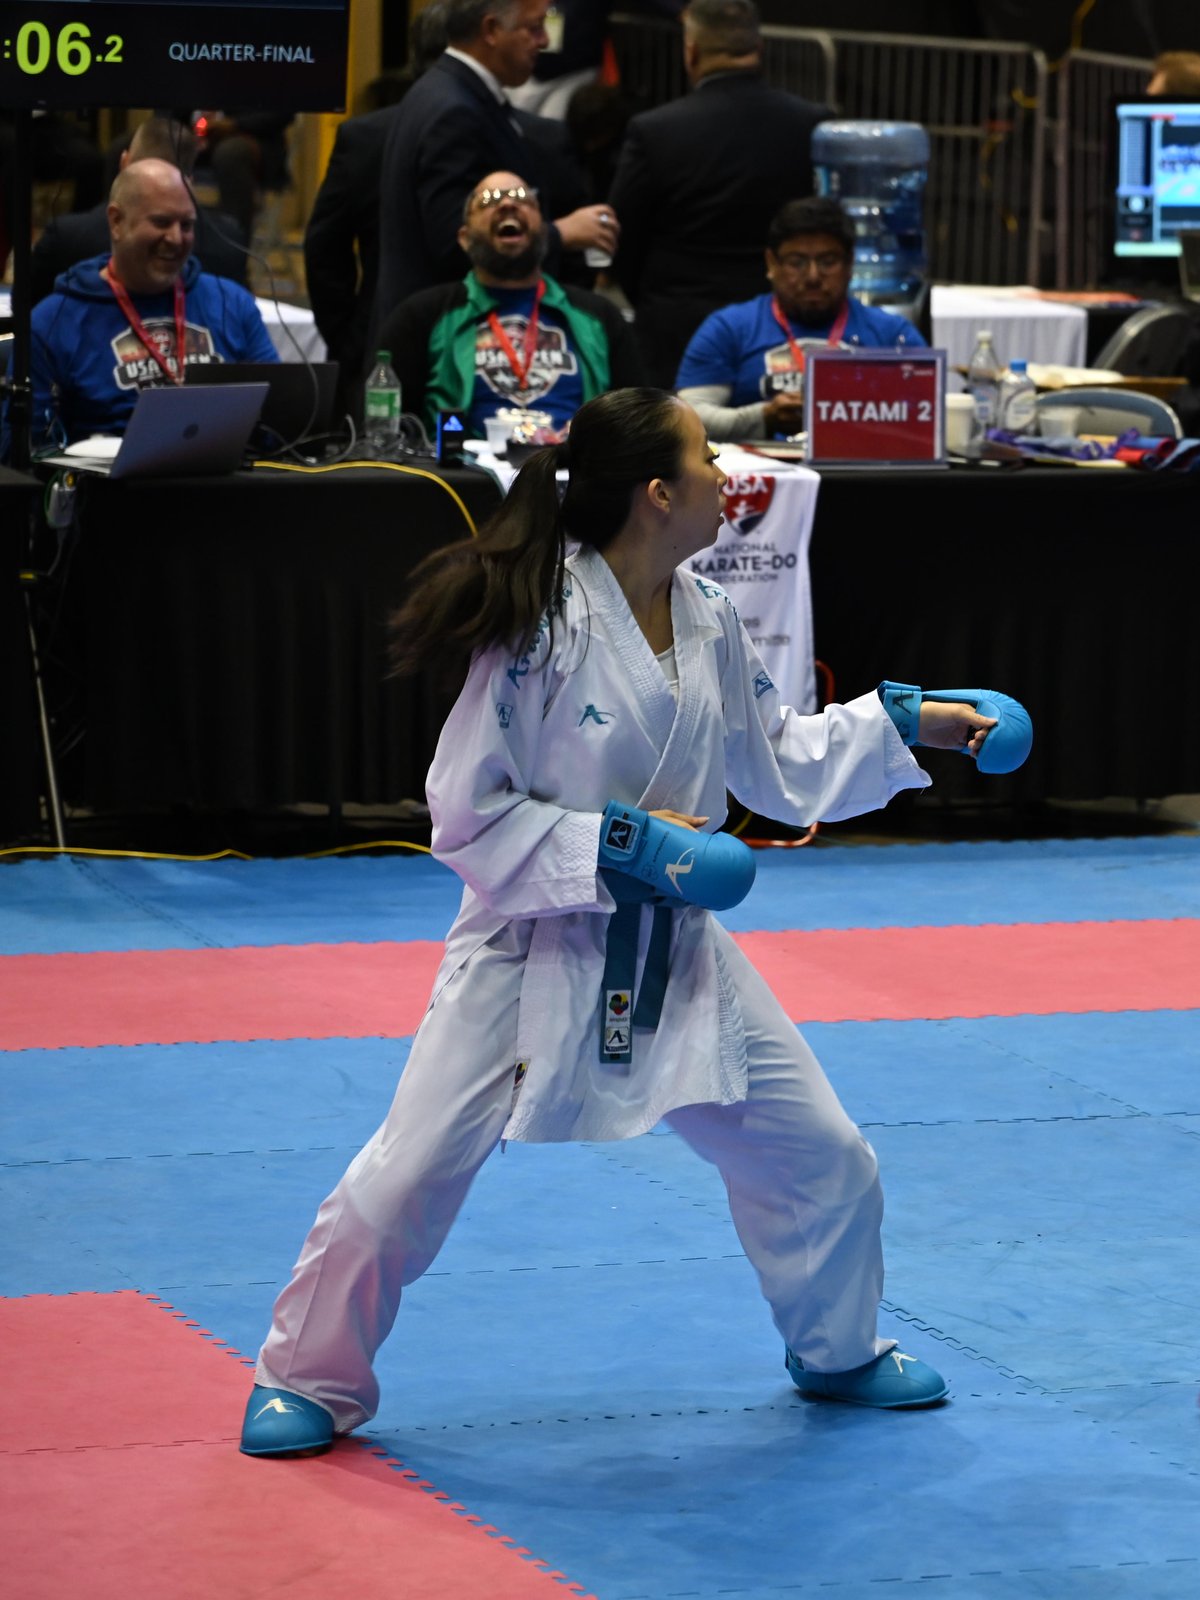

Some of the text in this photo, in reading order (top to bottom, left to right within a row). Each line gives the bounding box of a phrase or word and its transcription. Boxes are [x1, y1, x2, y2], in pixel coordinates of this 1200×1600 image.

[168, 42, 316, 64] QUARTER-FINAL
[816, 400, 932, 422] TATAMI 2
[722, 474, 768, 496] USA
[713, 541, 777, 557] NATIONAL
[692, 553, 797, 575] KARATE-DO
